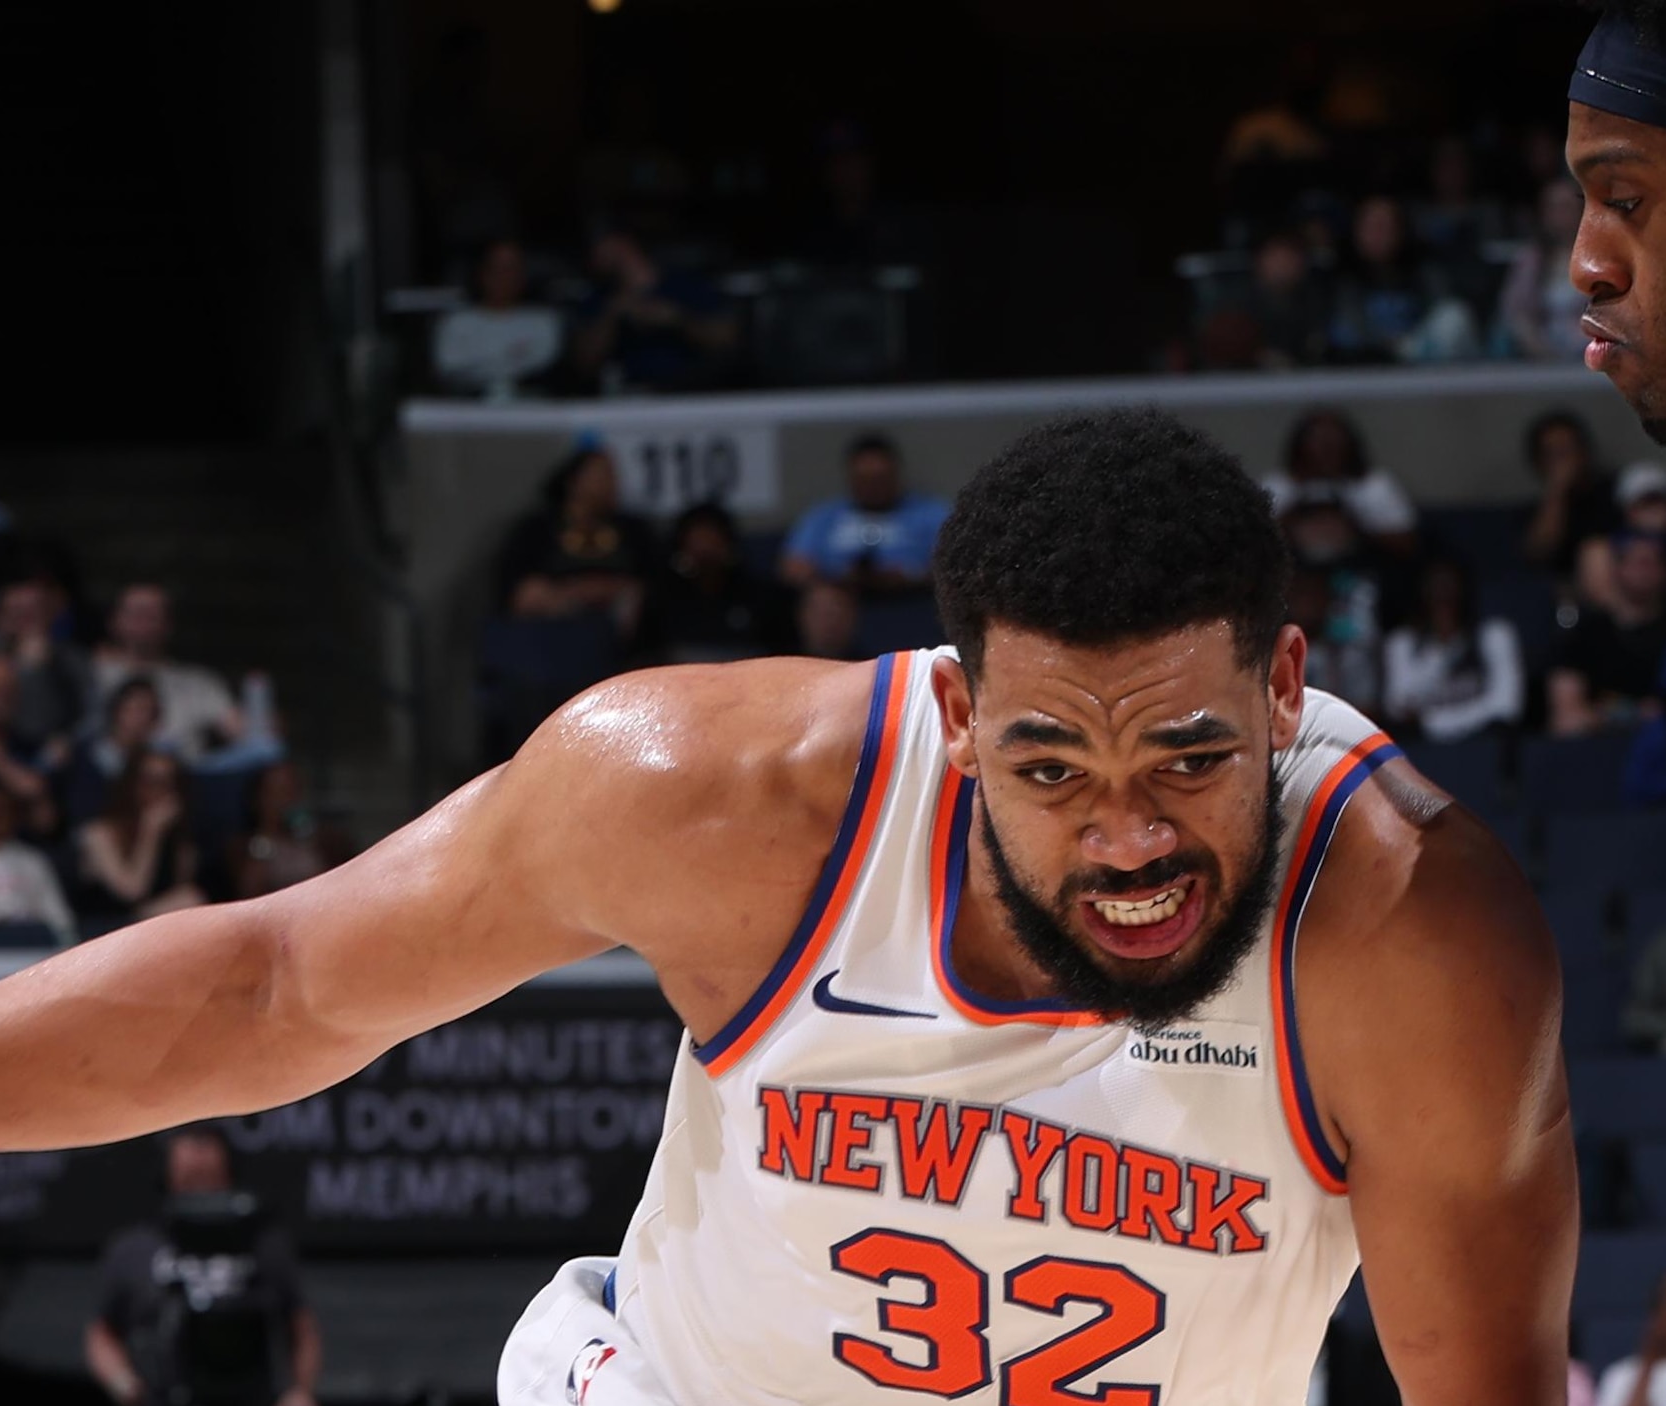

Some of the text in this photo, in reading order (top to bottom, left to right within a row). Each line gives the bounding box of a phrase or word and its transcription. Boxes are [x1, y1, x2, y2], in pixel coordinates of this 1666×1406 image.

[638, 434, 741, 497] 110
[408, 1020, 673, 1082] MINUTES
[1130, 1040, 1257, 1068] abu dhabi
[344, 1088, 664, 1152] DOWNTOW
[306, 1155, 591, 1218] MEMPHIS
[757, 1083, 1269, 1257] NEW YORK
